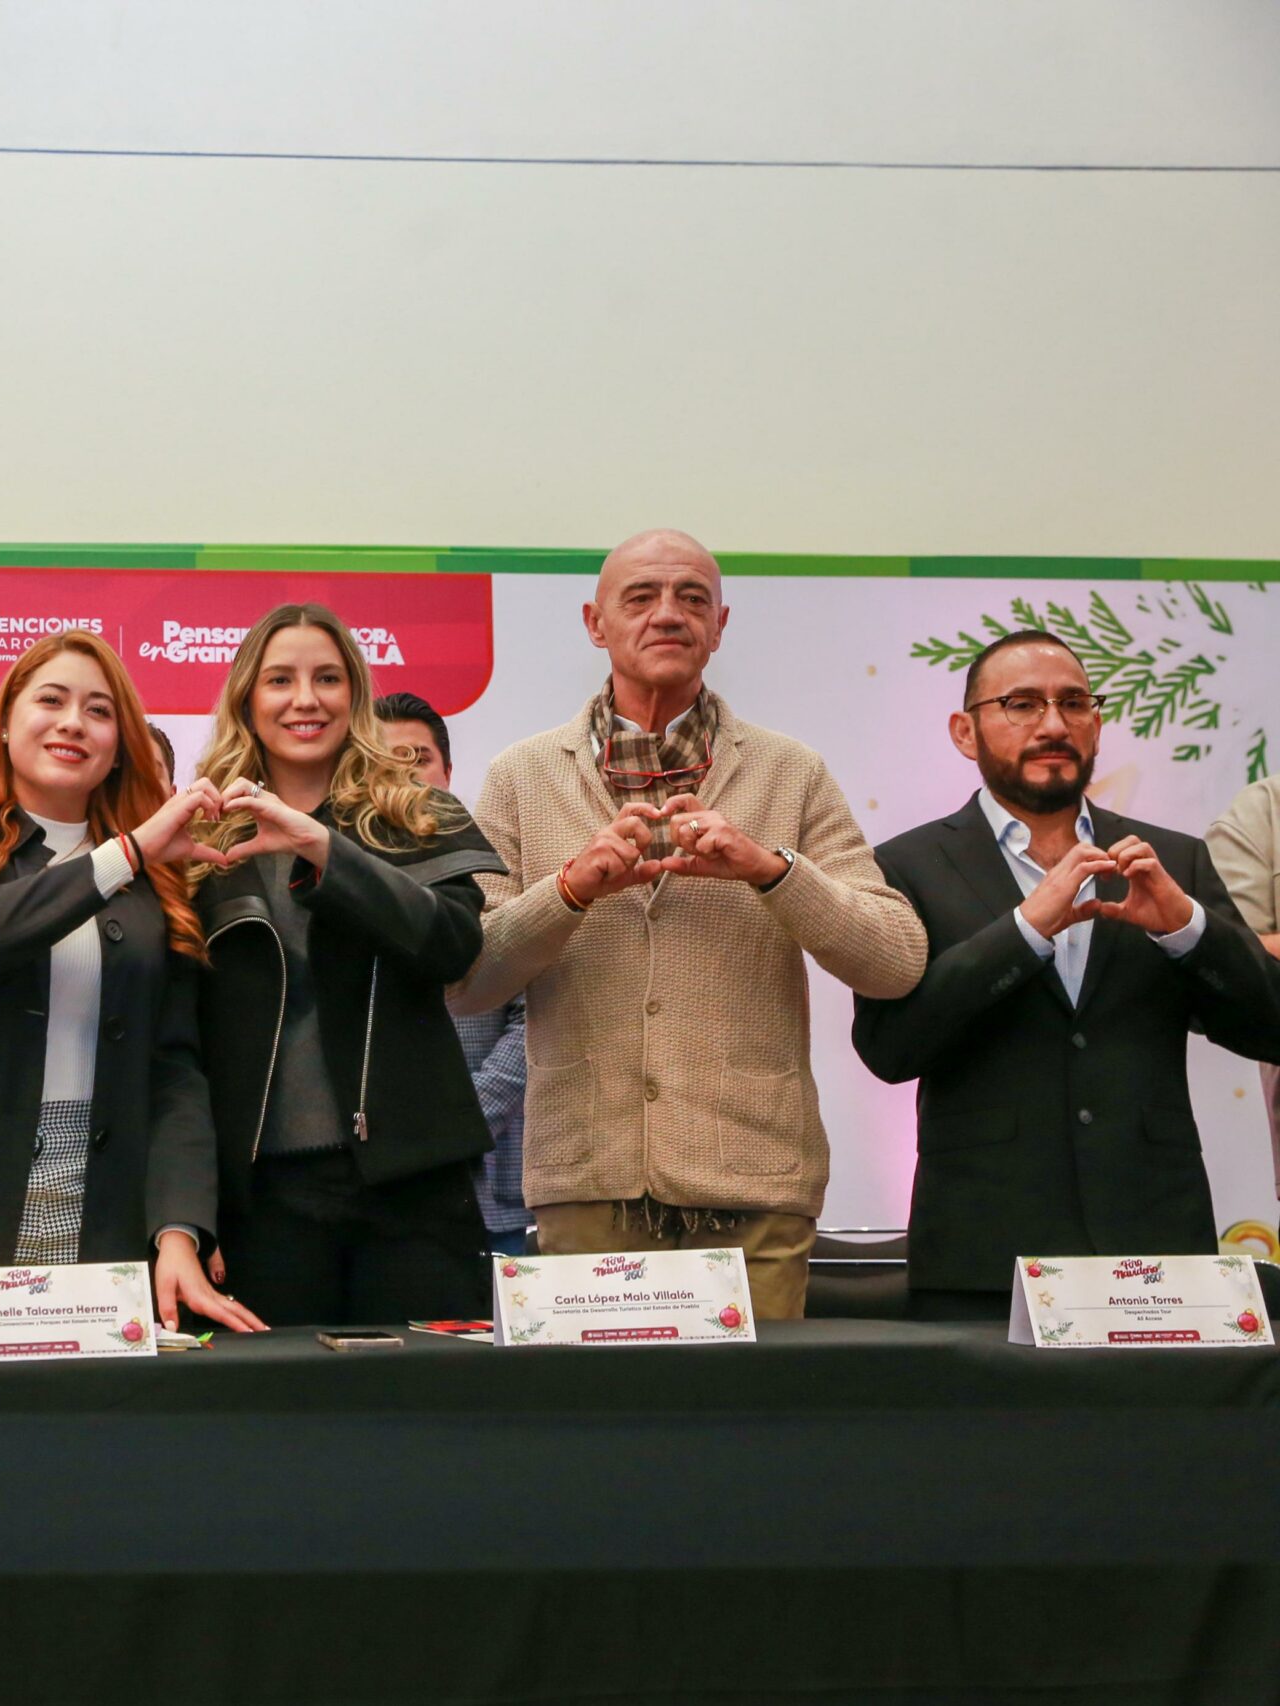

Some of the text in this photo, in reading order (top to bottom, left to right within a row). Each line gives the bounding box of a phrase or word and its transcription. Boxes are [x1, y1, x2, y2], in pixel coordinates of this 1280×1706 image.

[554, 1290, 694, 1306] Carla López Malo Villalón
[1108, 1295, 1183, 1306] Antonio Torres
[25, 1306, 73, 1316] Talavera
[77, 1305, 118, 1314] Herrera
